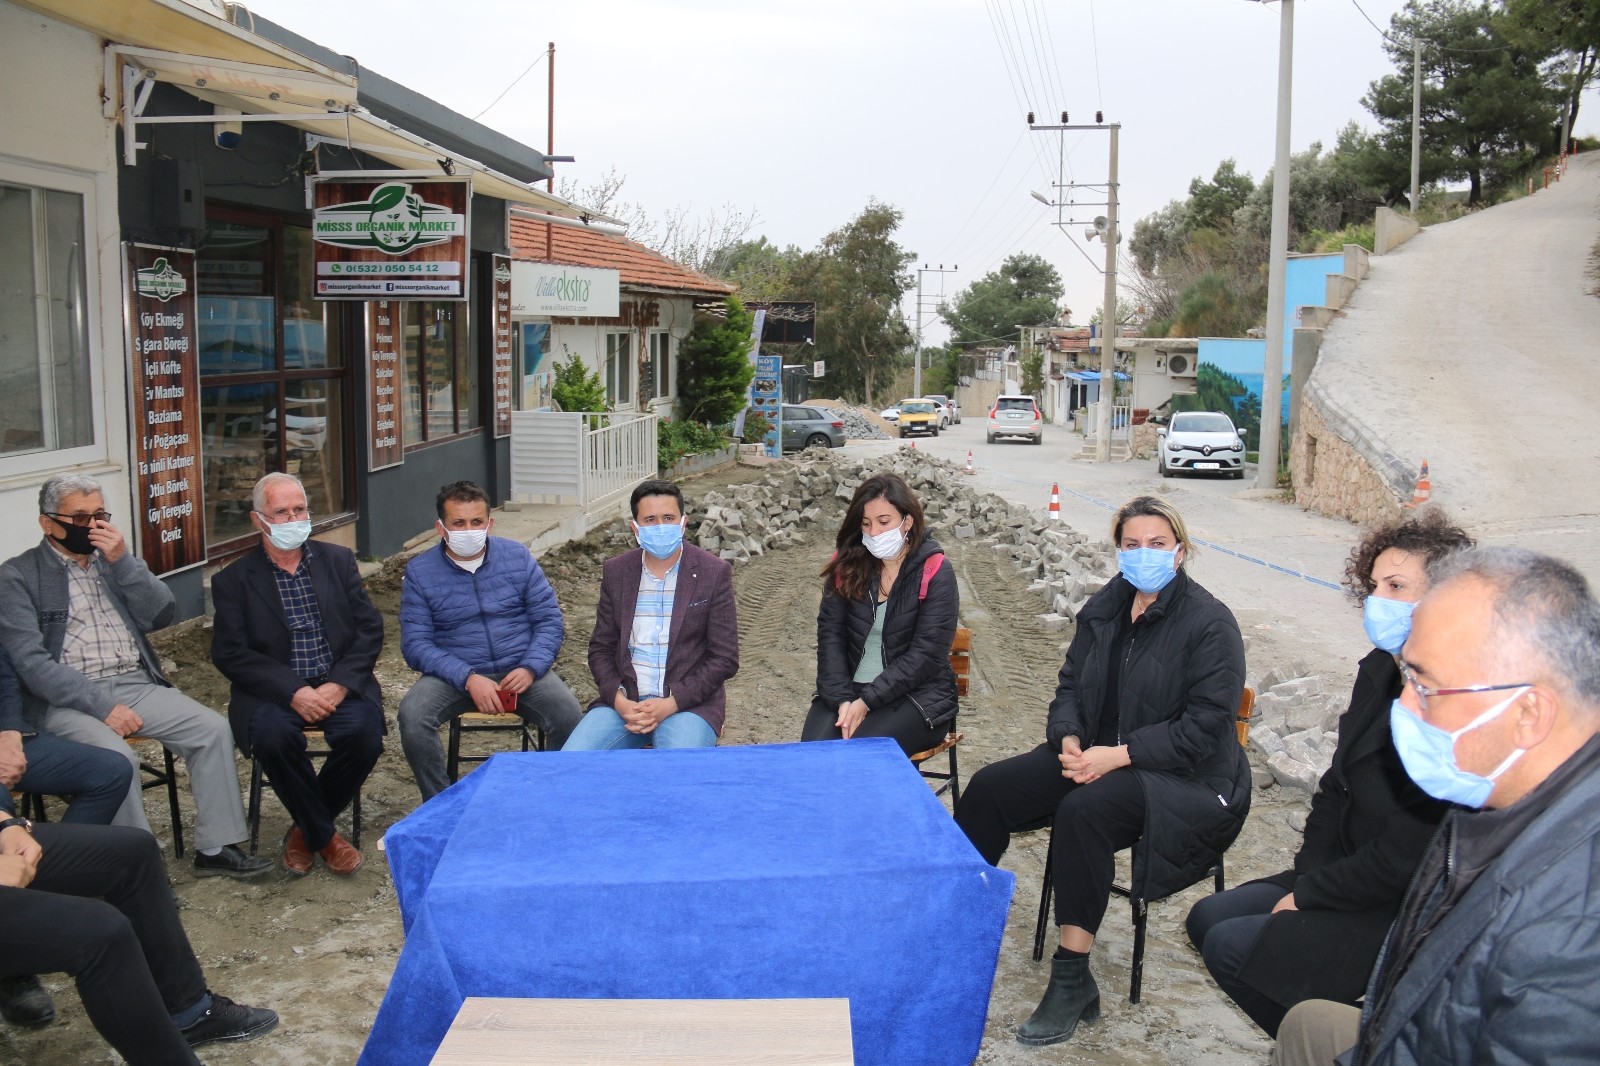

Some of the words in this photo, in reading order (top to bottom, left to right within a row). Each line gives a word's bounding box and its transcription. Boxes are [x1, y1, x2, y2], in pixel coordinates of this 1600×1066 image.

[408, 221, 457, 232] MARKET
[346, 264, 381, 273] 0(532)
[385, 264, 406, 273] 050
[408, 264, 423, 273] 54
[426, 264, 439, 273] 12
[327, 283, 381, 291] misssorganikmarket
[394, 283, 450, 292] misssorganikmarket
[540, 304, 588, 312] www.villaekstra.com
[155, 312, 183, 330] Ekmeği
[135, 337, 161, 355] Sgara
[163, 336, 188, 354] Böreği
[145, 358, 158, 380] İçli
[160, 360, 181, 376] Köfte
[155, 386, 184, 400] Mantısı
[148, 410, 182, 425] Bazlama
[153, 432, 188, 450] Poğaçası
[167, 455, 194, 471] Katmer
[166, 478, 188, 495] Börek
[161, 500, 192, 520] Tereyağı
[161, 526, 181, 544] Ceviz
